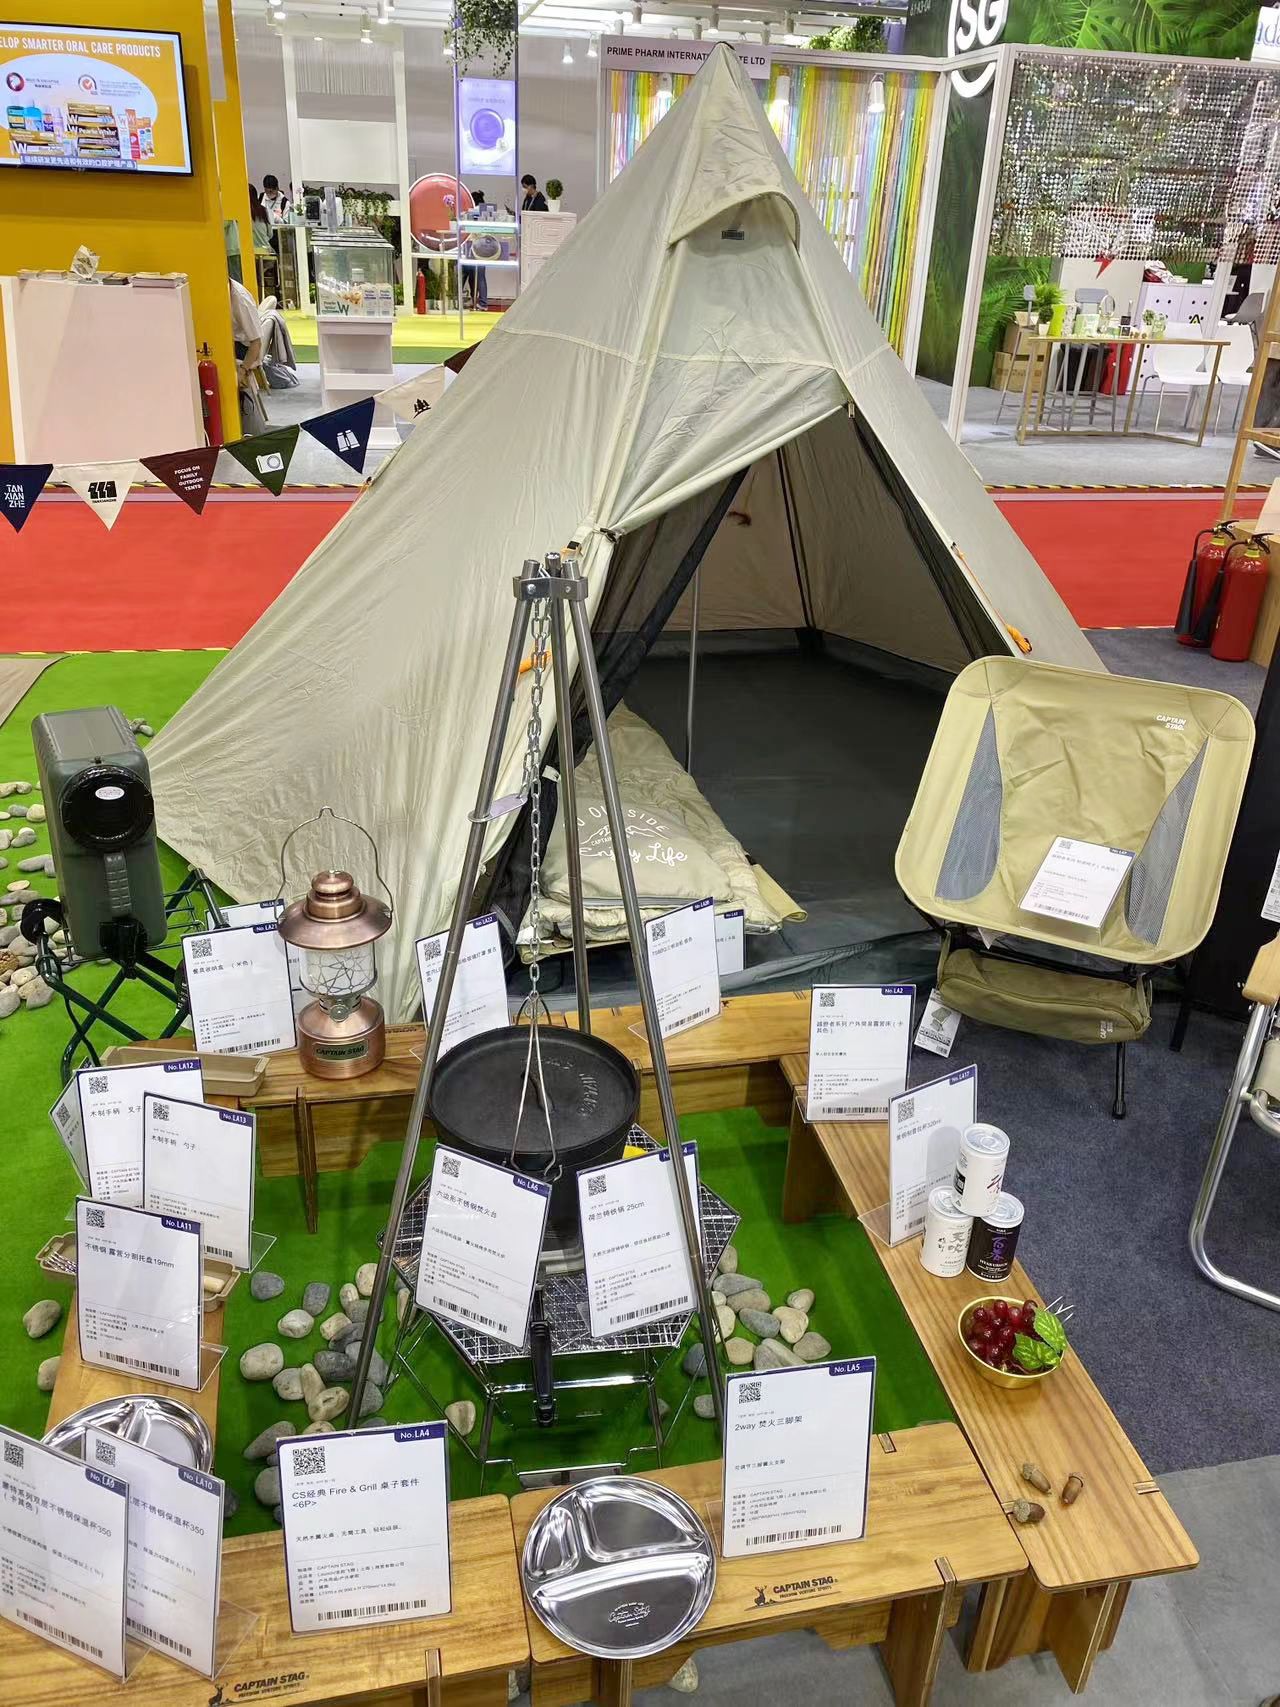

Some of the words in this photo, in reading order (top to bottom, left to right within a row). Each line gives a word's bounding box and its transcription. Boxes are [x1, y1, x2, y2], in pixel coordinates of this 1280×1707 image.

[22, 38, 64, 50] SMARTER
[66, 40, 88, 52] ORAL
[91, 42, 113, 54] CARE
[116, 43, 160, 57] PRODUCTS
[606, 46, 633, 56] PRIME
[635, 48, 665, 58] PHARM
[738, 56, 748, 64] TE
[750, 56, 766, 66] LTD
[174, 467, 190, 475] FOCUS
[180, 472, 198, 480] FAMILY
[178, 478, 204, 486] OUTDOOR
[6, 484, 24, 493] TAN
[4, 492, 24, 500] XIAN
[9, 500, 26, 508] ZHE
[1156, 714, 1186, 725] CAPTAIN
[580, 847, 640, 864] Enjy
[646, 842, 688, 867] Life
[316, 1048, 346, 1056] CAPTAIN
[348, 1046, 364, 1055] STAG
[168, 1062, 194, 1070] No.LA12
[90, 1108, 120, 1118] 木制手柄
[222, 1112, 247, 1124] No.LA13
[151, 1134, 177, 1147] 木制手柄
[518, 1178, 538, 1192] No.LA6
[588, 1206, 625, 1222] 荷兰铸铁锅
[626, 1201, 645, 1212] 25cm
[166, 1220, 192, 1231] No.LA11
[834, 1364, 860, 1373] No.LA5
[734, 1420, 756, 1432] 2way
[758, 1415, 803, 1428] 焚火三脚架
[400, 1429, 430, 1440] No.LA4
[90, 1472, 115, 1488] No.LA9
[183, 1471, 212, 1490] No.LA10
[292, 1488, 326, 1500] CS经典
[329, 1486, 347, 1496] Fire
[359, 1483, 378, 1492] Grill
[380, 1478, 420, 1490] 桌子套件
[292, 1500, 318, 1509] <6P>
[772, 1580, 810, 1594] CAPTAIN
[812, 1576, 834, 1586] STAG
[234, 1677, 278, 1692] CAPTAIN
[280, 1672, 305, 1684] STAG
